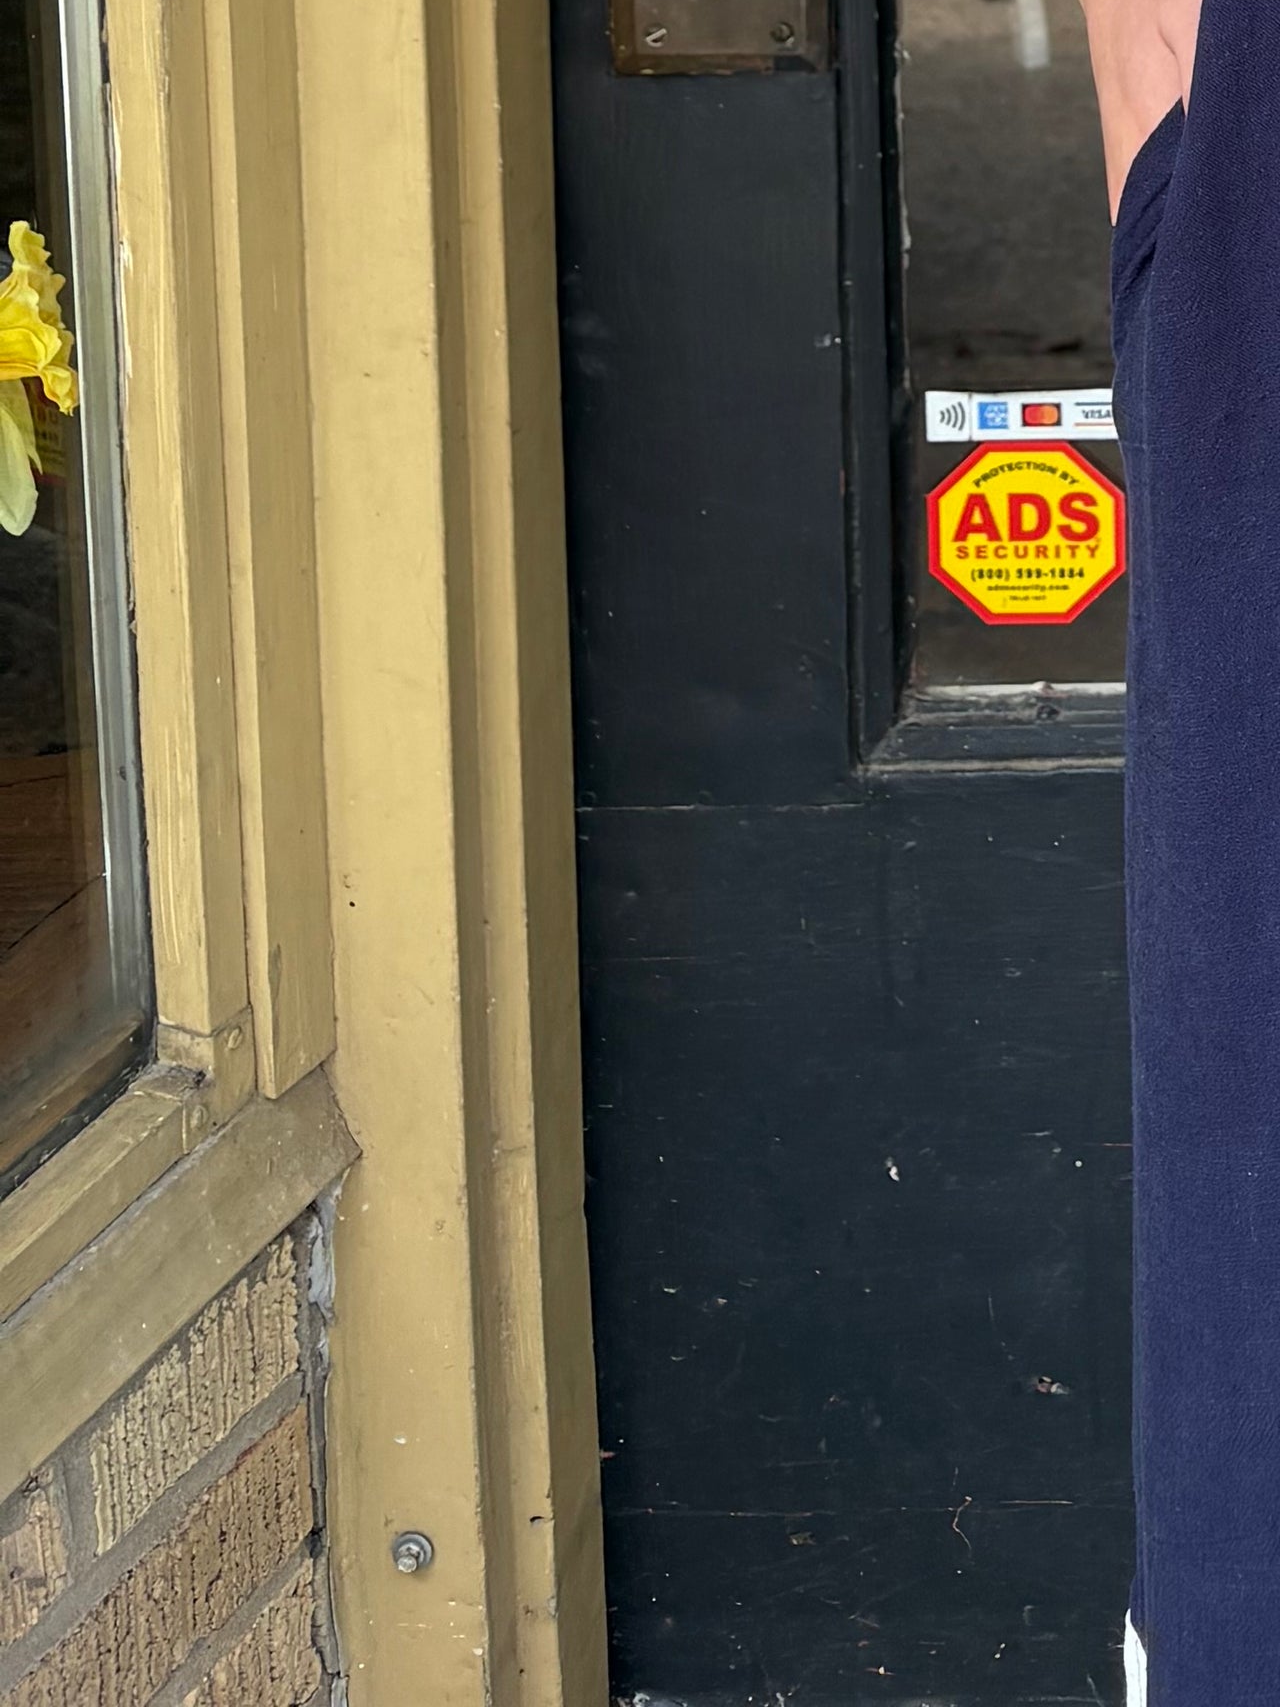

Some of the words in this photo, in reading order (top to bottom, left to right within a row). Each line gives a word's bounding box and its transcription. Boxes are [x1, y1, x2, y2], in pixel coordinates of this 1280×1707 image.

[973, 461, 1058, 487] PROTECTION
[1059, 471, 1079, 485] BY
[952, 492, 1100, 542] ADS
[955, 545, 1099, 559] SECURITY
